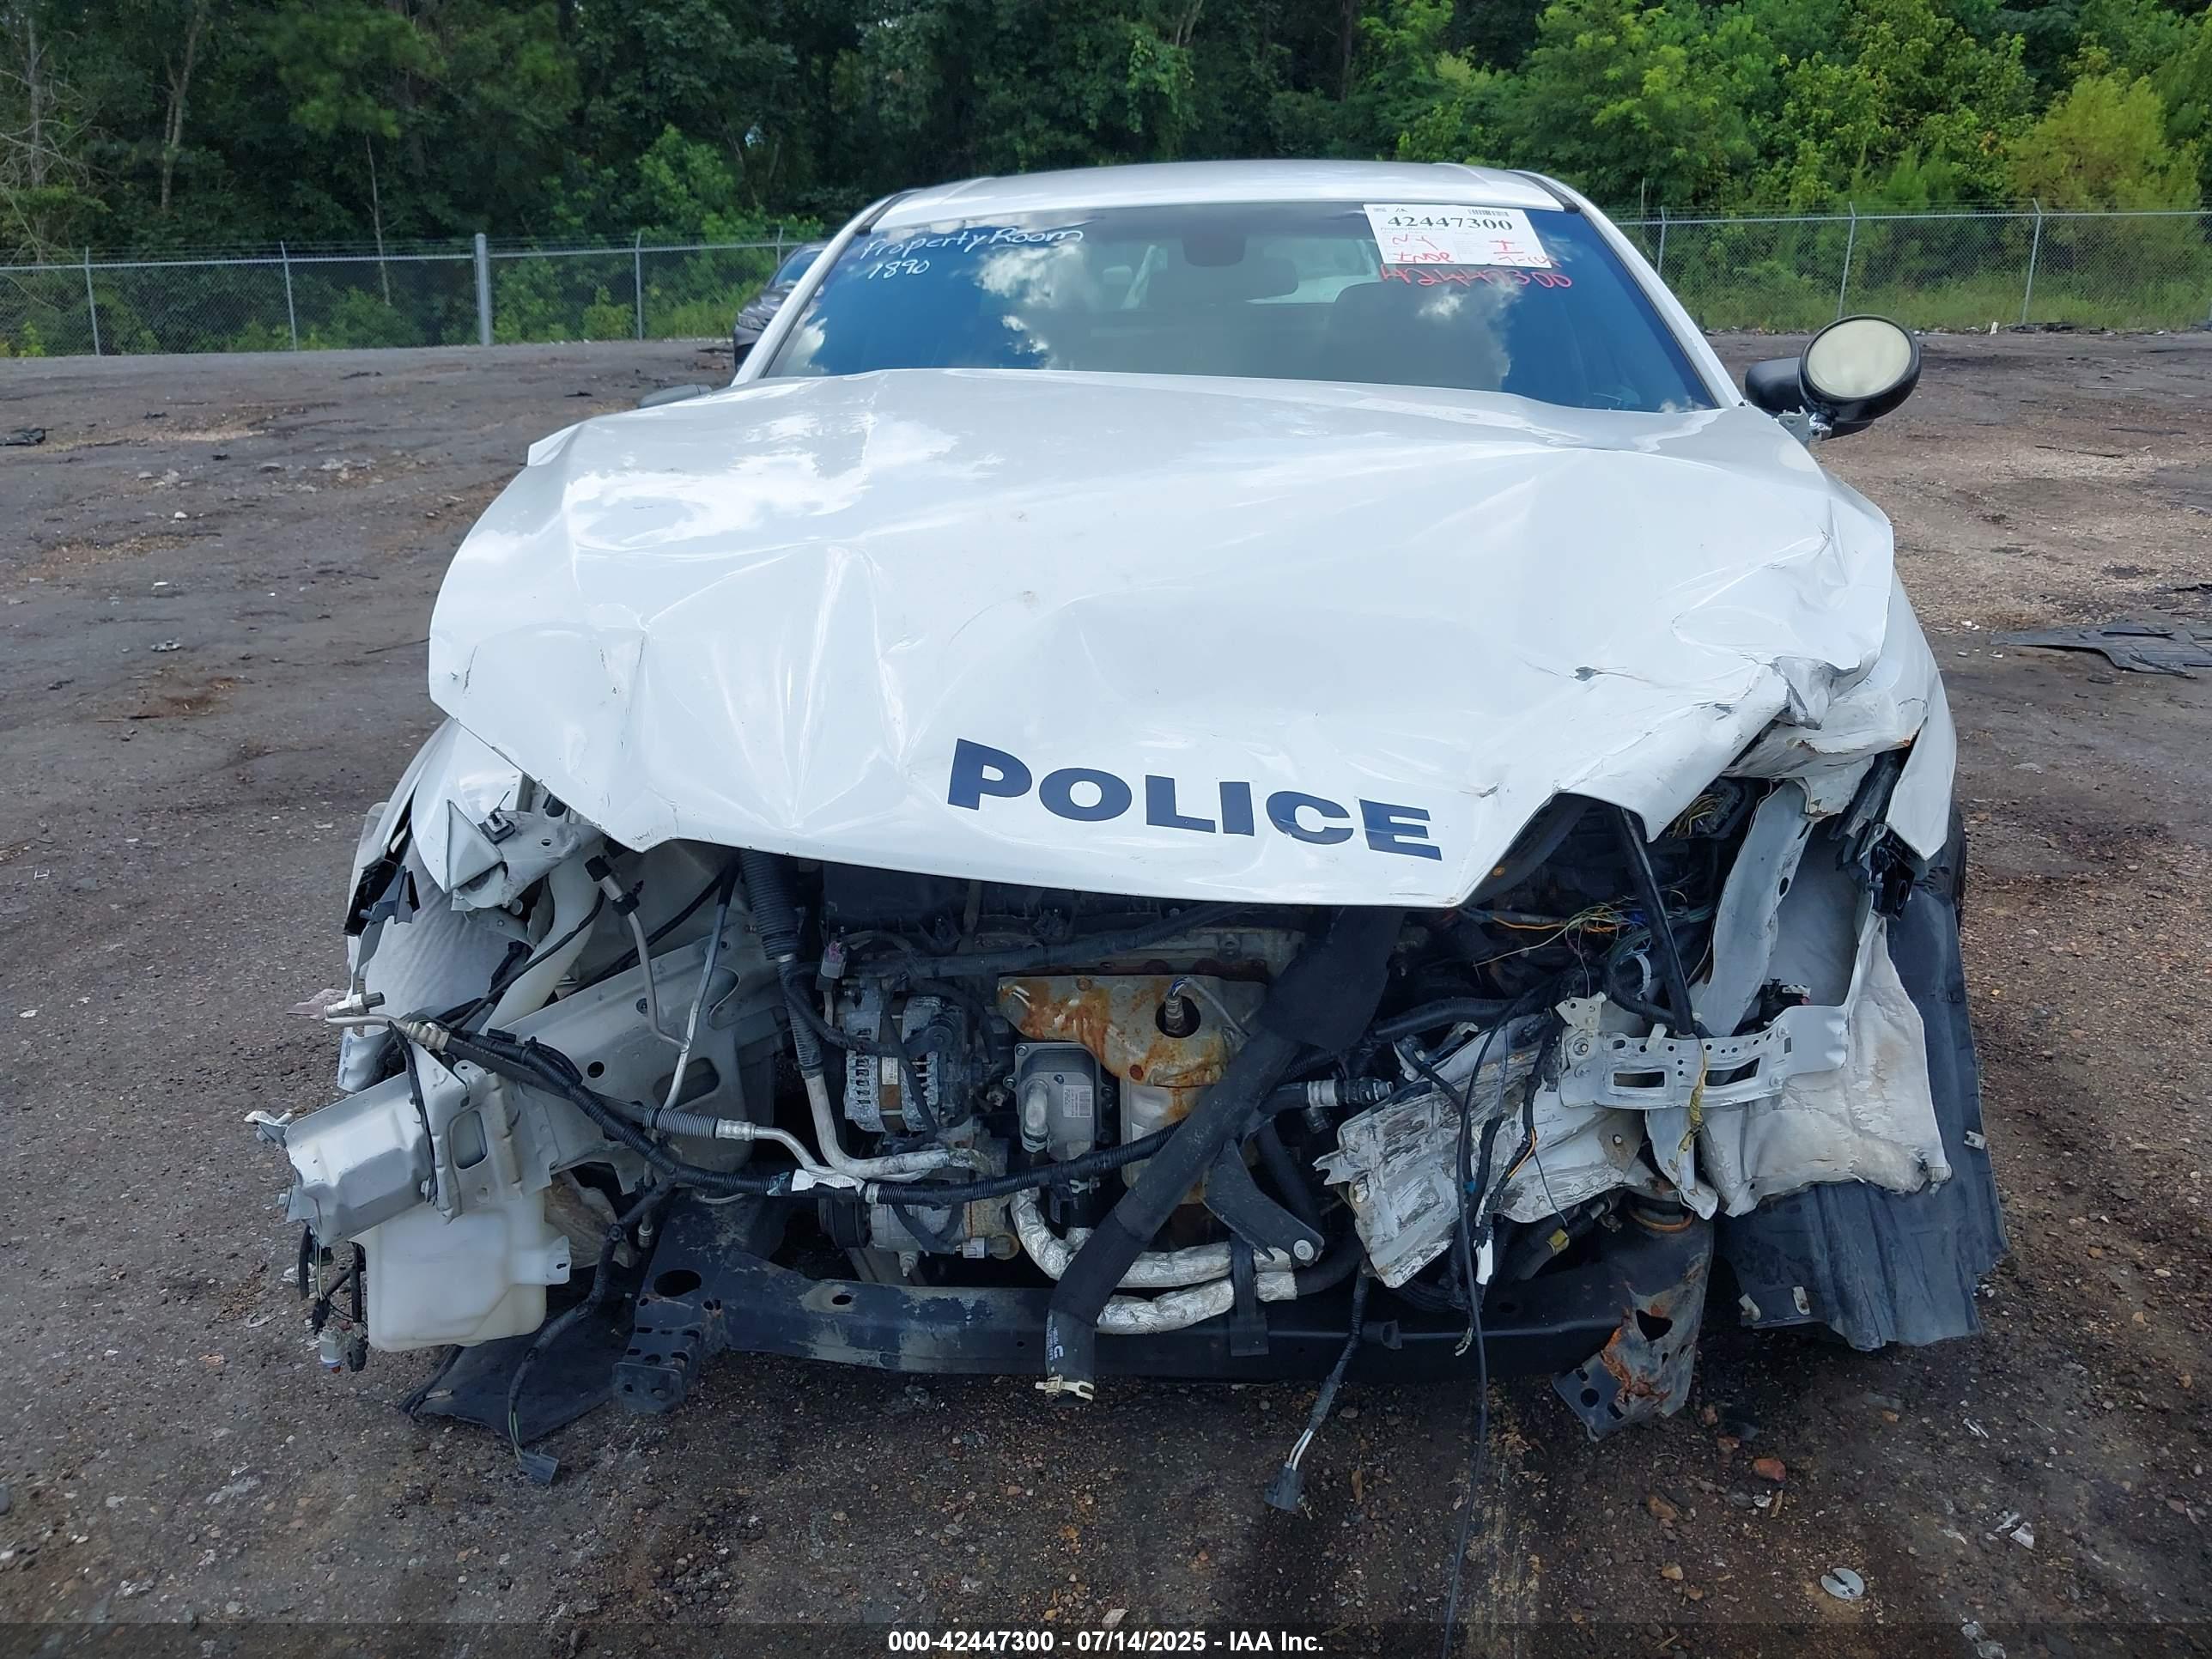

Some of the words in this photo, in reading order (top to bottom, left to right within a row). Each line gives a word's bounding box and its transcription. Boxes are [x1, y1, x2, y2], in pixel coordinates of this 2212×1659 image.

[1387, 216, 1513, 230] 42447300
[860, 230, 988, 260] Property
[988, 228, 1084, 245] Room
[868, 258, 930, 280] 1890
[1380, 264, 1572, 289] 42447300
[948, 738, 1443, 860] POLICE
